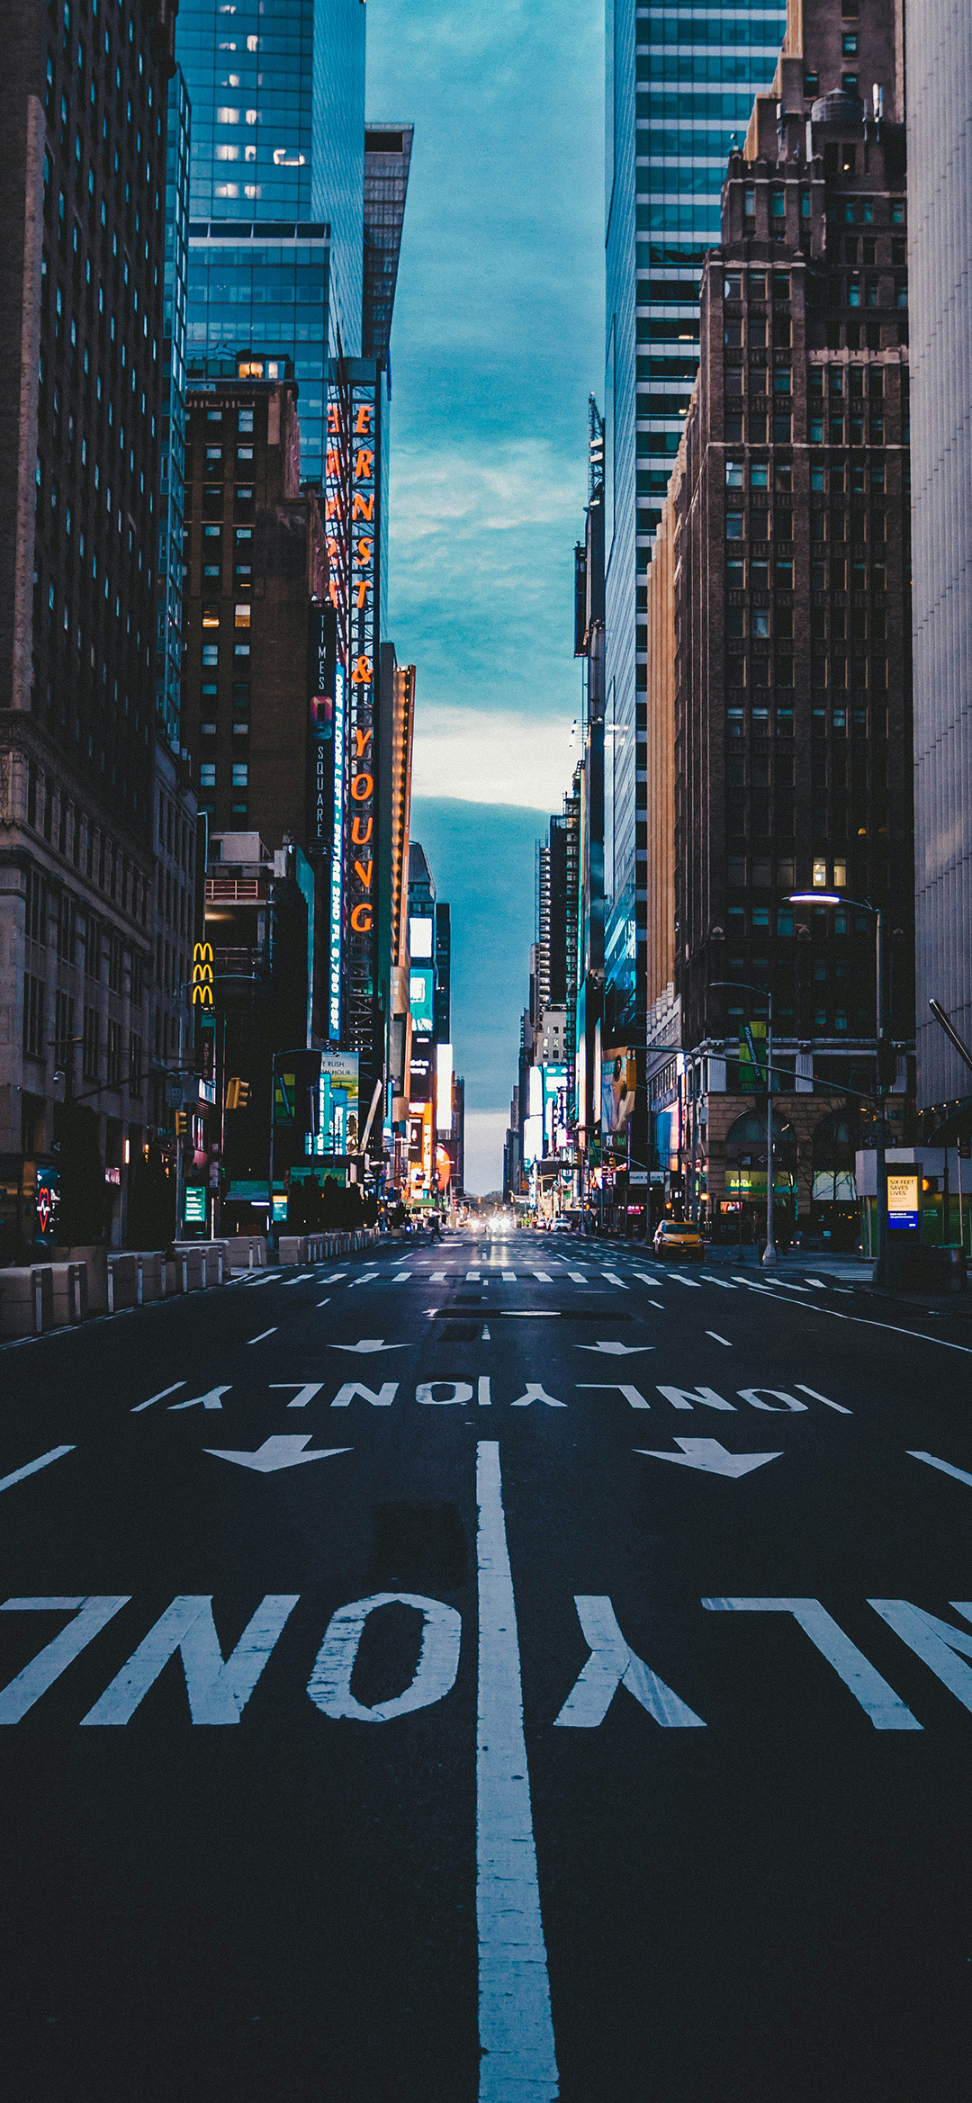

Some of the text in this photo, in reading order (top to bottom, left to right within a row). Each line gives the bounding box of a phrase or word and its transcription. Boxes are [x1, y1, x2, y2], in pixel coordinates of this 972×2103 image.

[352, 405, 374, 608] ERNST
[318, 614, 326, 690] TIMES
[352, 656, 373, 683] &
[334, 711, 343, 765] FLOOR
[316, 746, 324, 837] SQUARE
[327, 1060, 345, 1068] RUSH
[166, 1381, 474, 1409] ONLY
[510, 1383, 809, 1412] ONLY
